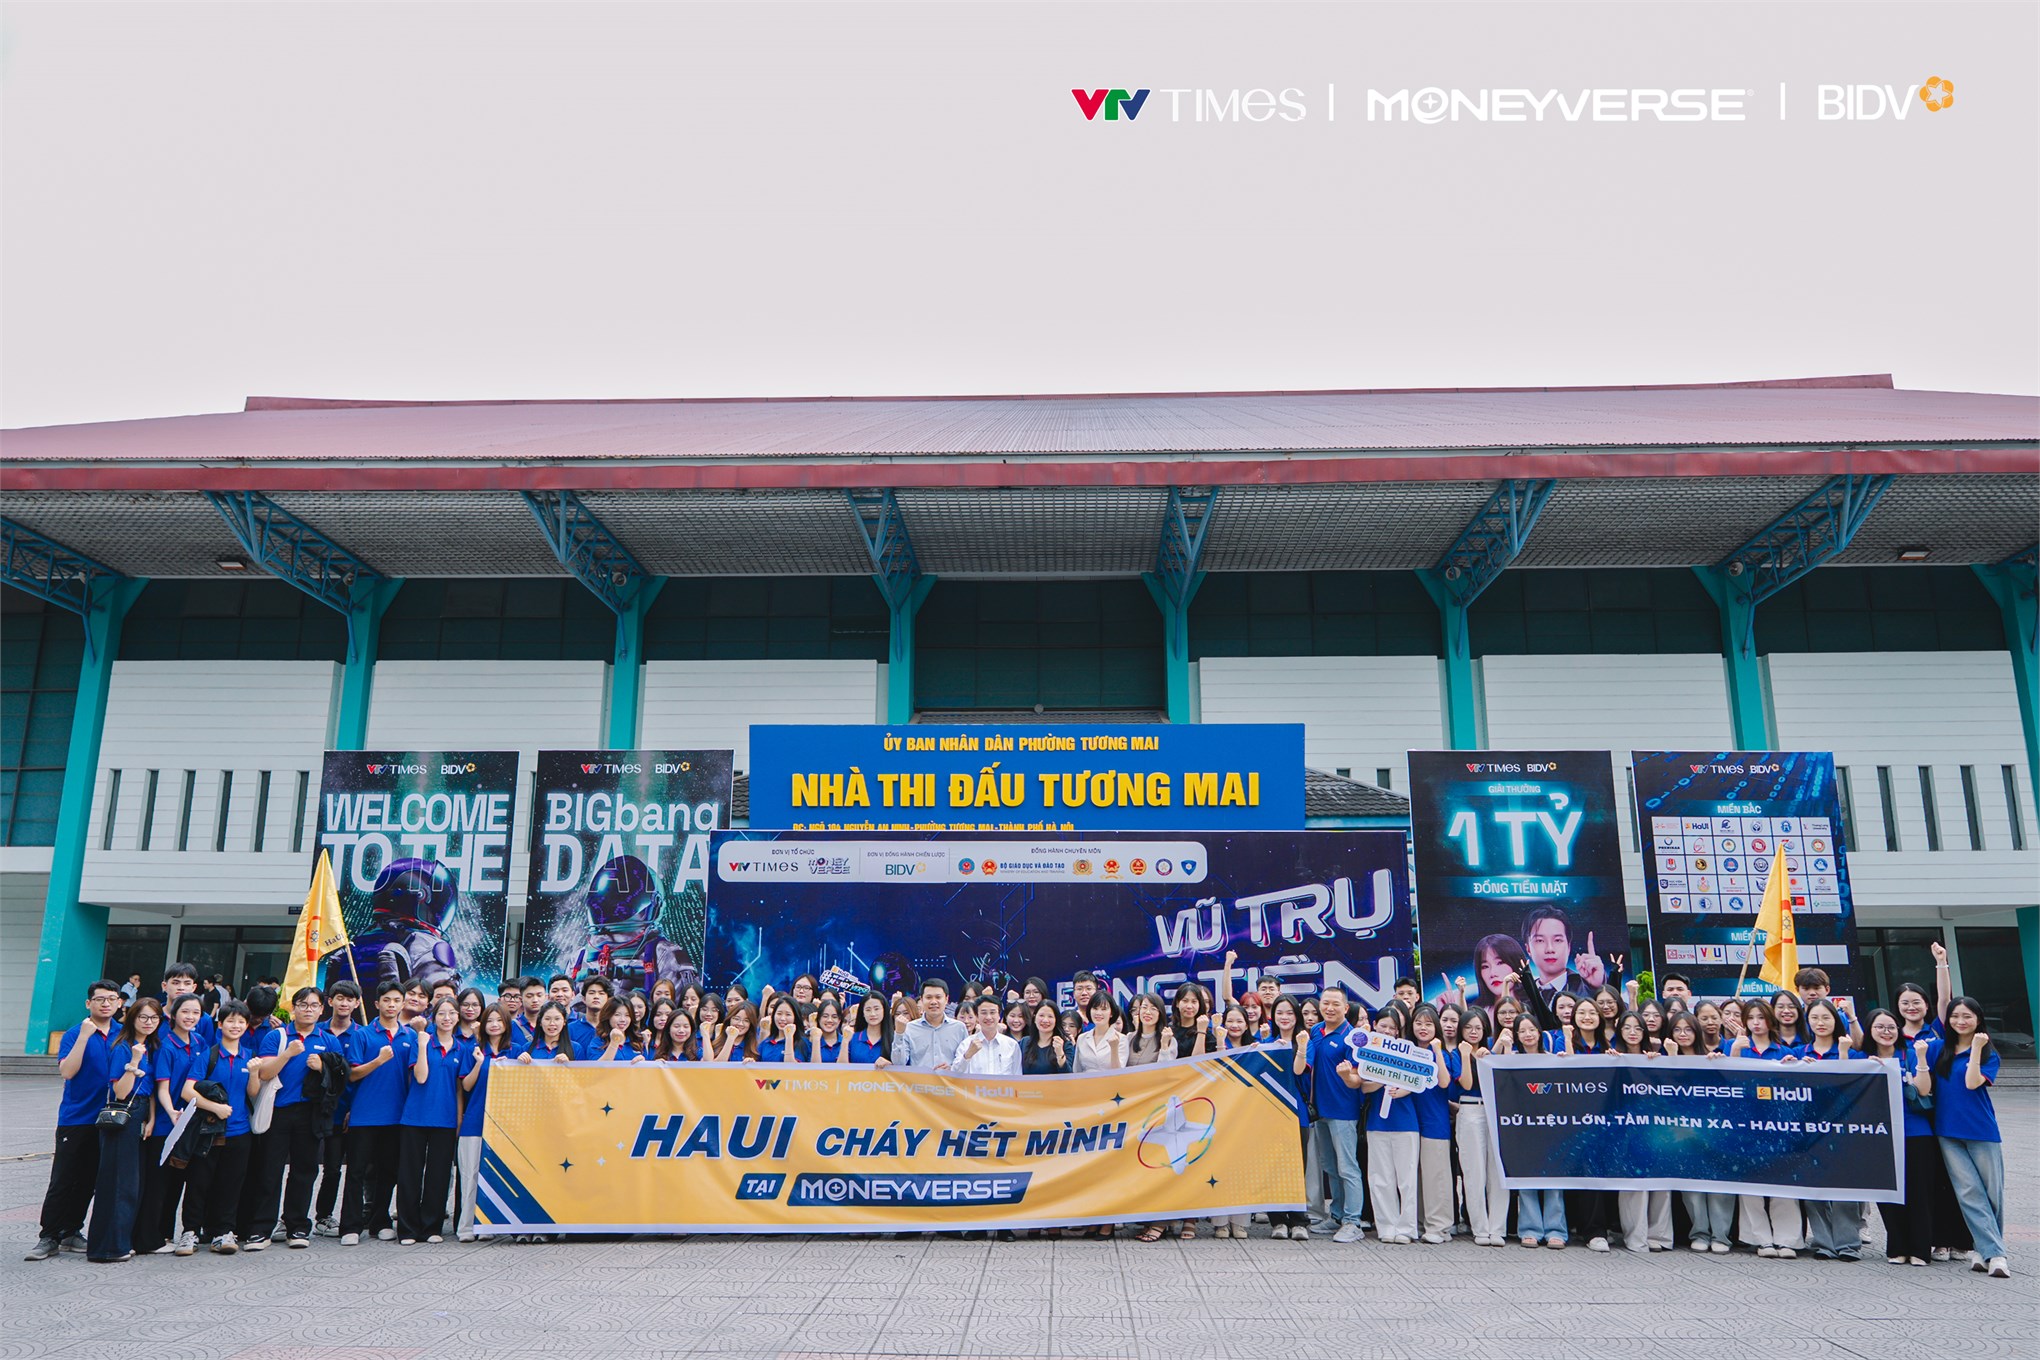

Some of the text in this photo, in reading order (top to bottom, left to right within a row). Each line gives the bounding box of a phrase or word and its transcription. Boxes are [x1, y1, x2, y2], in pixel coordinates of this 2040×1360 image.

[884, 733, 1159, 751] ỦY BAN NHÂN DÂN PHƯỜNG TƯƠNG MAI
[367, 764, 388, 775] VTV
[440, 764, 466, 775] BIDV
[581, 764, 602, 774] VTV
[655, 763, 681, 774] BIDV
[1466, 764, 1484, 773] VTV
[1527, 764, 1549, 773] BIDV
[1690, 764, 1708, 774] VTV
[1750, 764, 1772, 774] BIDV
[791, 761, 1260, 807] NHÀ THI ĐẤU TƯƠNG MAI
[326, 793, 508, 832] WELCOME
[1717, 803, 1762, 814] MIỀN BẮC
[1448, 793, 1583, 866] 1 TỶ
[321, 833, 506, 893] TO THE
[540, 834, 710, 894] DATA
[729, 862, 750, 872] VTV
[885, 864, 916, 876] BIDV
[1473, 880, 1569, 896] ĐỒNG TIỀN MẶT
[1235, 868, 1393, 946] TRỤ
[1155, 896, 1226, 958] VŨ
[1731, 932, 1754, 941] MIỀN
[1740, 982, 1763, 993] MIỀN
[1382, 1039, 1410, 1055] HaUI
[1366, 1065, 1420, 1087] KHAI TRÍ TUỆ
[755, 1079, 780, 1090] VTV
[848, 1081, 955, 1096] MONEYVERSE
[975, 1086, 1014, 1098] HaUI
[1527, 1083, 1552, 1094] VTV
[1622, 1083, 1744, 1098] MONEYVERSE
[1773, 1086, 1812, 1102] HaUI
[1500, 1114, 1523, 1126] DỮ
[1526, 1115, 1567, 1128] LIỆU
[1572, 1113, 1611, 1127] LỚN,
[1654, 1114, 1703, 1129] NHÌN
[1707, 1119, 1733, 1129] XA
[1750, 1120, 1801, 1132] HAUI
[1805, 1120, 1843, 1134] BỨT
[1848, 1120, 1888, 1135] PHÁ
[630, 1114, 798, 1160] HAUI
[815, 1120, 1128, 1158] CHÁY HẾT MÌNH
[746, 1180, 776, 1196] TẠI
[801, 1178, 1013, 1202] MONEYVERSE
